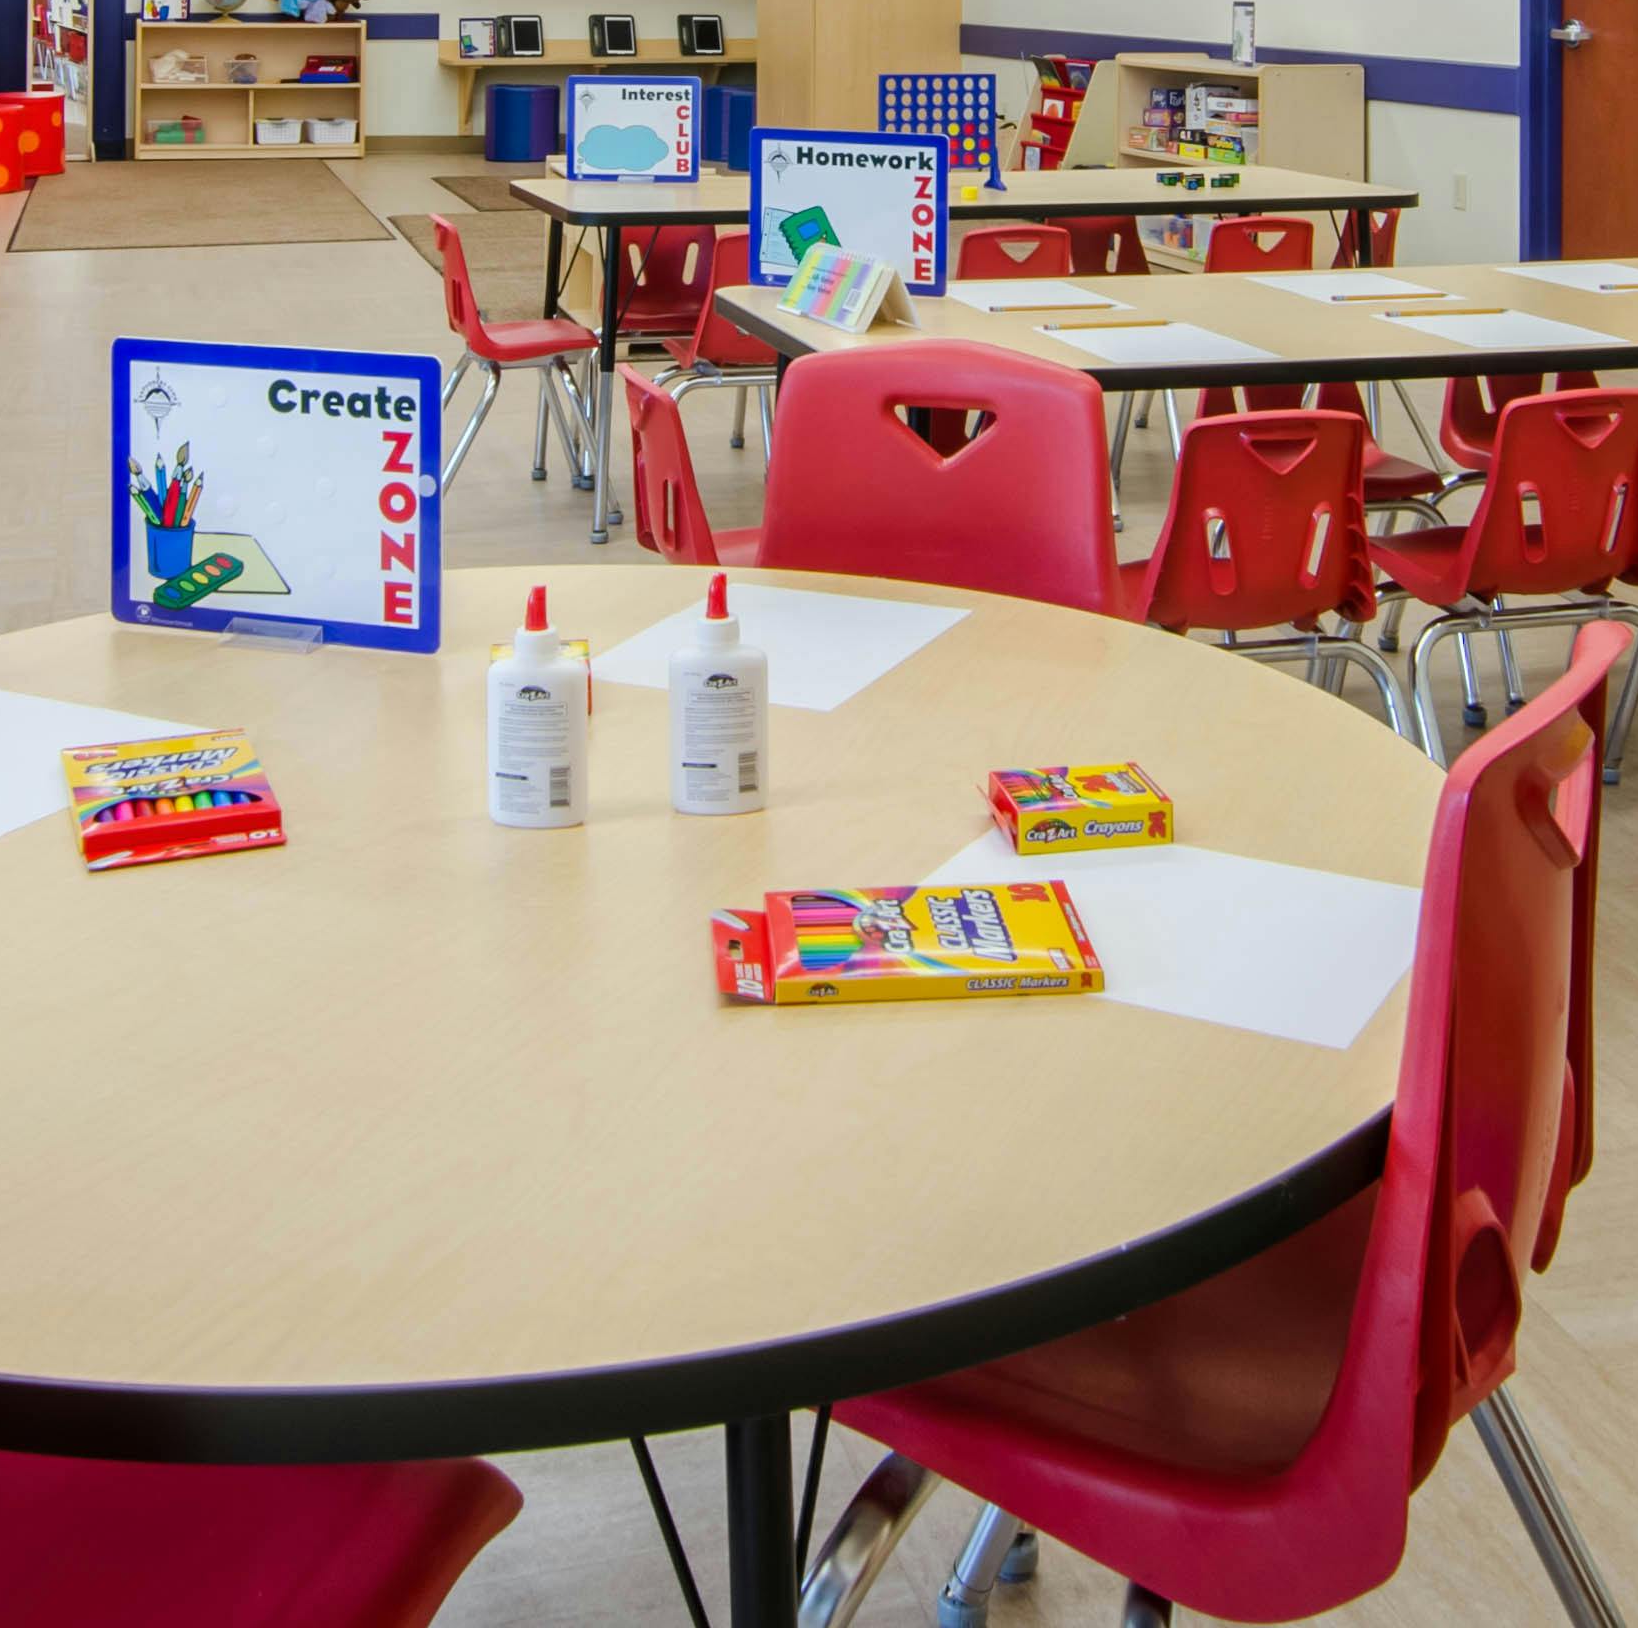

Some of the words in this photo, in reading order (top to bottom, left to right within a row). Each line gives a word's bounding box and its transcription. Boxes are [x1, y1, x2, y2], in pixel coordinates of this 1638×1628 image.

[621, 88, 691, 101] Interest
[676, 104, 690, 173] CLUB
[796, 146, 934, 171] Homework
[912, 176, 935, 281] ZONE
[268, 379, 416, 422] Create
[378, 430, 417, 624] ZONE
[85, 747, 239, 773] Markers
[115, 760, 223, 780] CLASSIC
[248, 828, 281, 841] 10
[1082, 820, 1145, 835] Crayons
[1007, 883, 1051, 902] 10
[926, 896, 970, 949] CLASSIC
[961, 888, 1018, 962] Markers
[737, 978, 765, 999] 10
[966, 977, 1016, 992] CLASSIC
[1019, 975, 1070, 990] Markers
